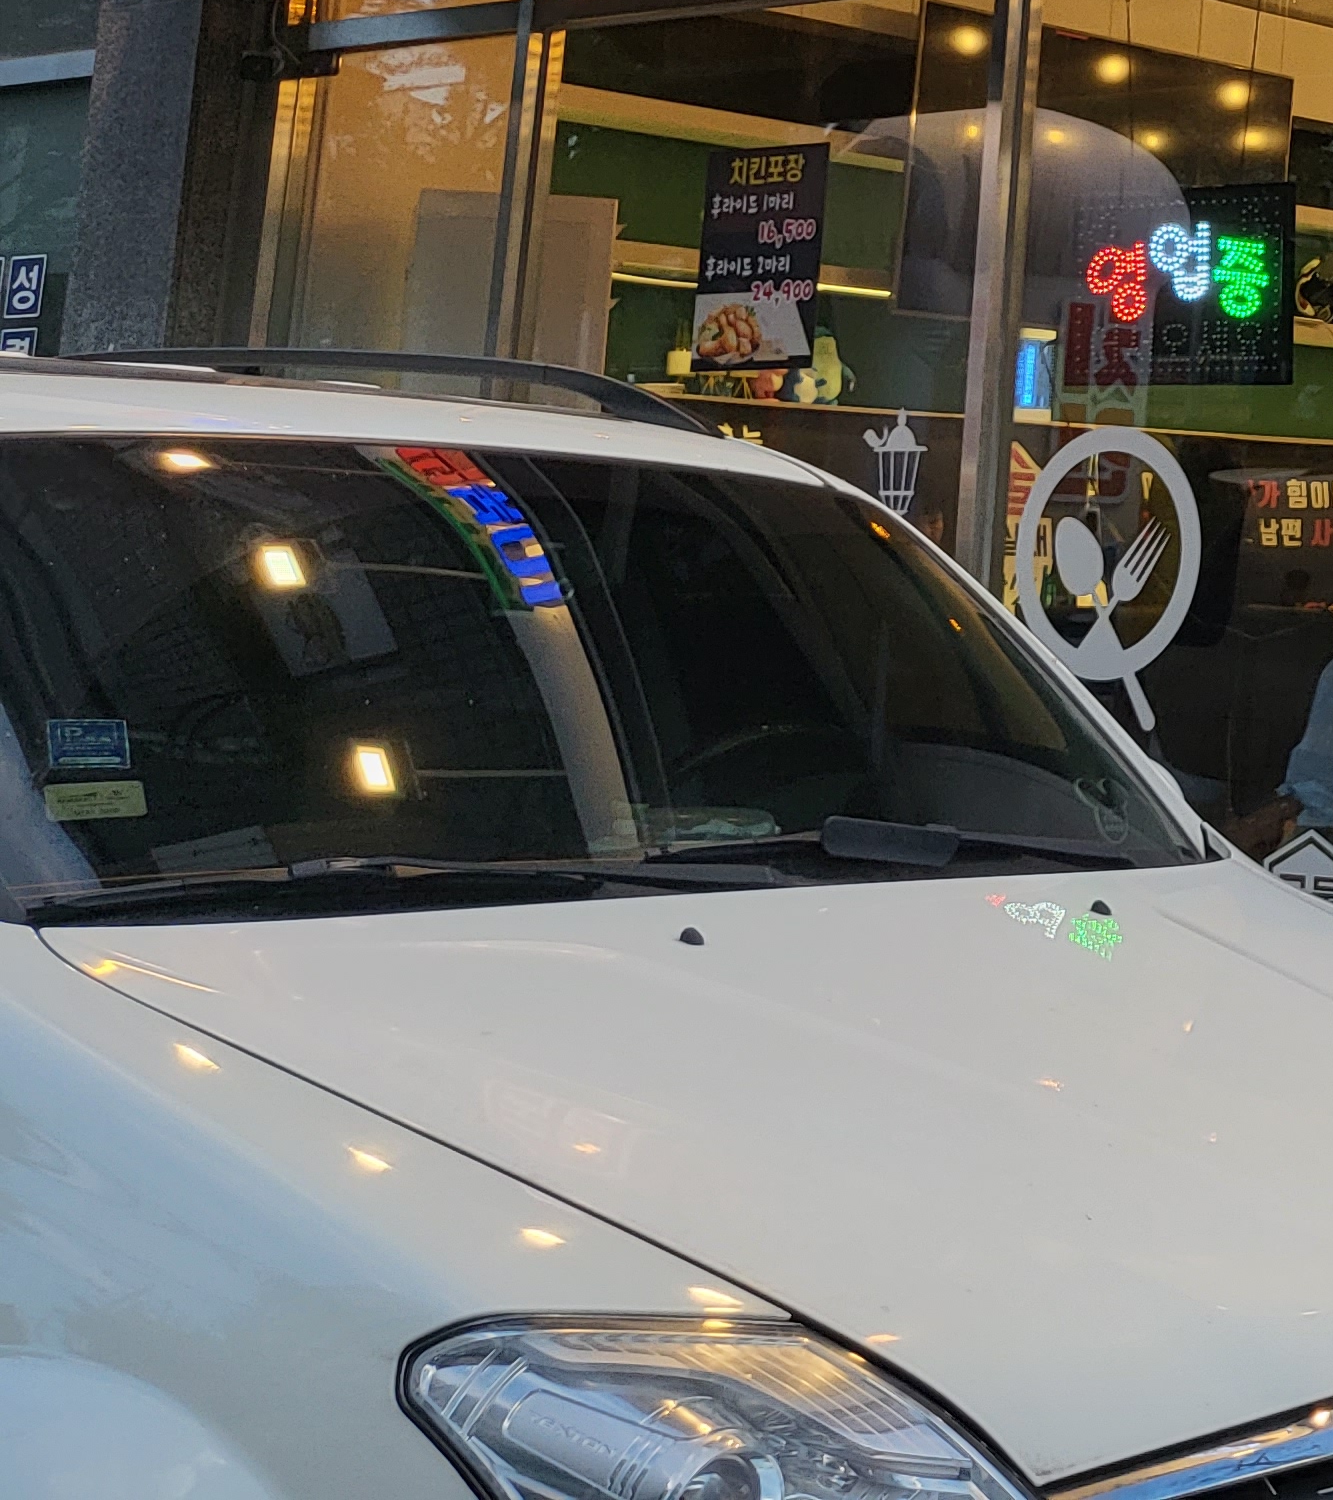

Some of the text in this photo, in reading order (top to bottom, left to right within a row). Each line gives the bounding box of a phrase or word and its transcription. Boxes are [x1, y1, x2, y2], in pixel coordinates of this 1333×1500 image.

[729, 153, 805, 186] 치킨포장
[757, 218, 817, 249] 16,500
[1086, 220, 1270, 323] 영업중
[751, 279, 814, 307] 24,900
[1258, 517, 1302, 547] 남편
